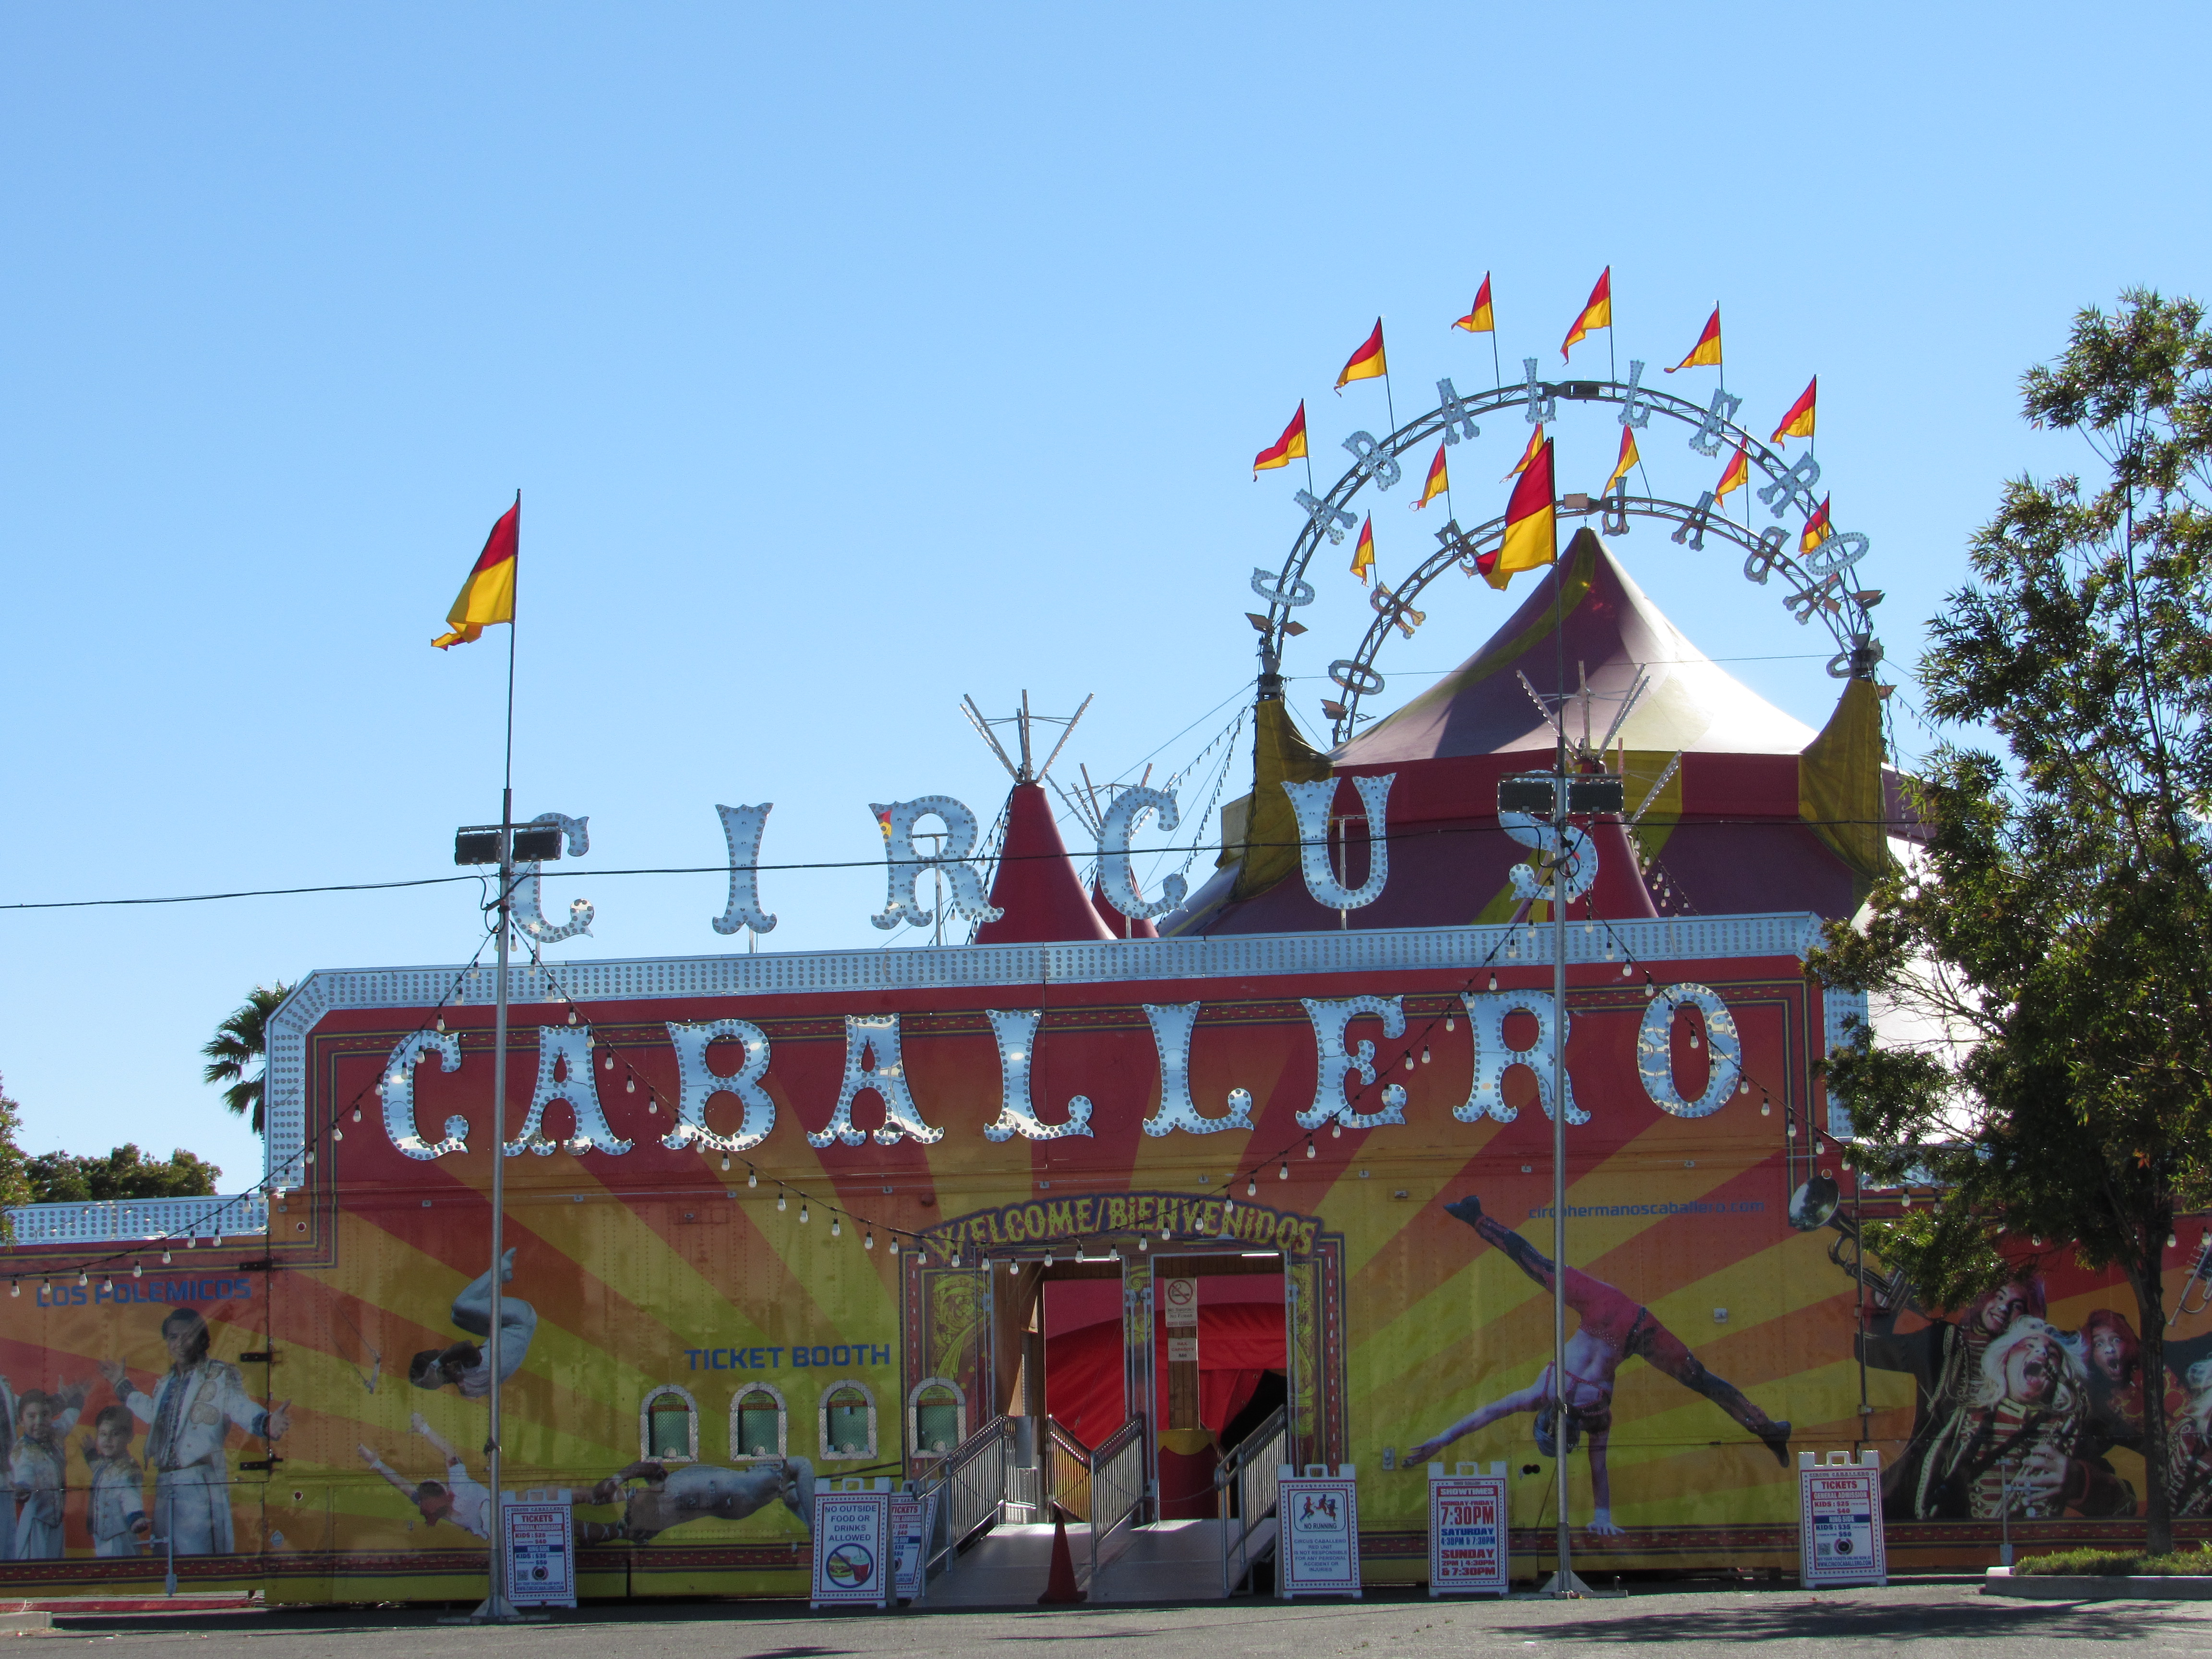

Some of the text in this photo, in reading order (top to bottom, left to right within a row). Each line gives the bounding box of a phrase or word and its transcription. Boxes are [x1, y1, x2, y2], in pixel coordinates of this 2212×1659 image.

[509, 769, 1599, 943] CIRCUS
[382, 982, 1742, 1162] CABALLERO
[1528, 1201, 1765, 1219] circhermanoscaballero.com
[36, 1278, 252, 1307] LOS POLEMICOS
[684, 1344, 891, 1370] TICKET BOOTH
[1821, 1480, 1857, 1489] TICKETS
[521, 1514, 553, 1522] TICKETS
[1441, 1506, 1494, 1525] 7:30PM
[1441, 1527, 1494, 1536] SATURDAY
[1441, 1537, 1464, 1545] 4:30PM
[1472, 1536, 1495, 1544] 7:30PM
[1441, 1549, 1494, 1559] SUNDAY
[1442, 1567, 1495, 1575] & 7:30PM
